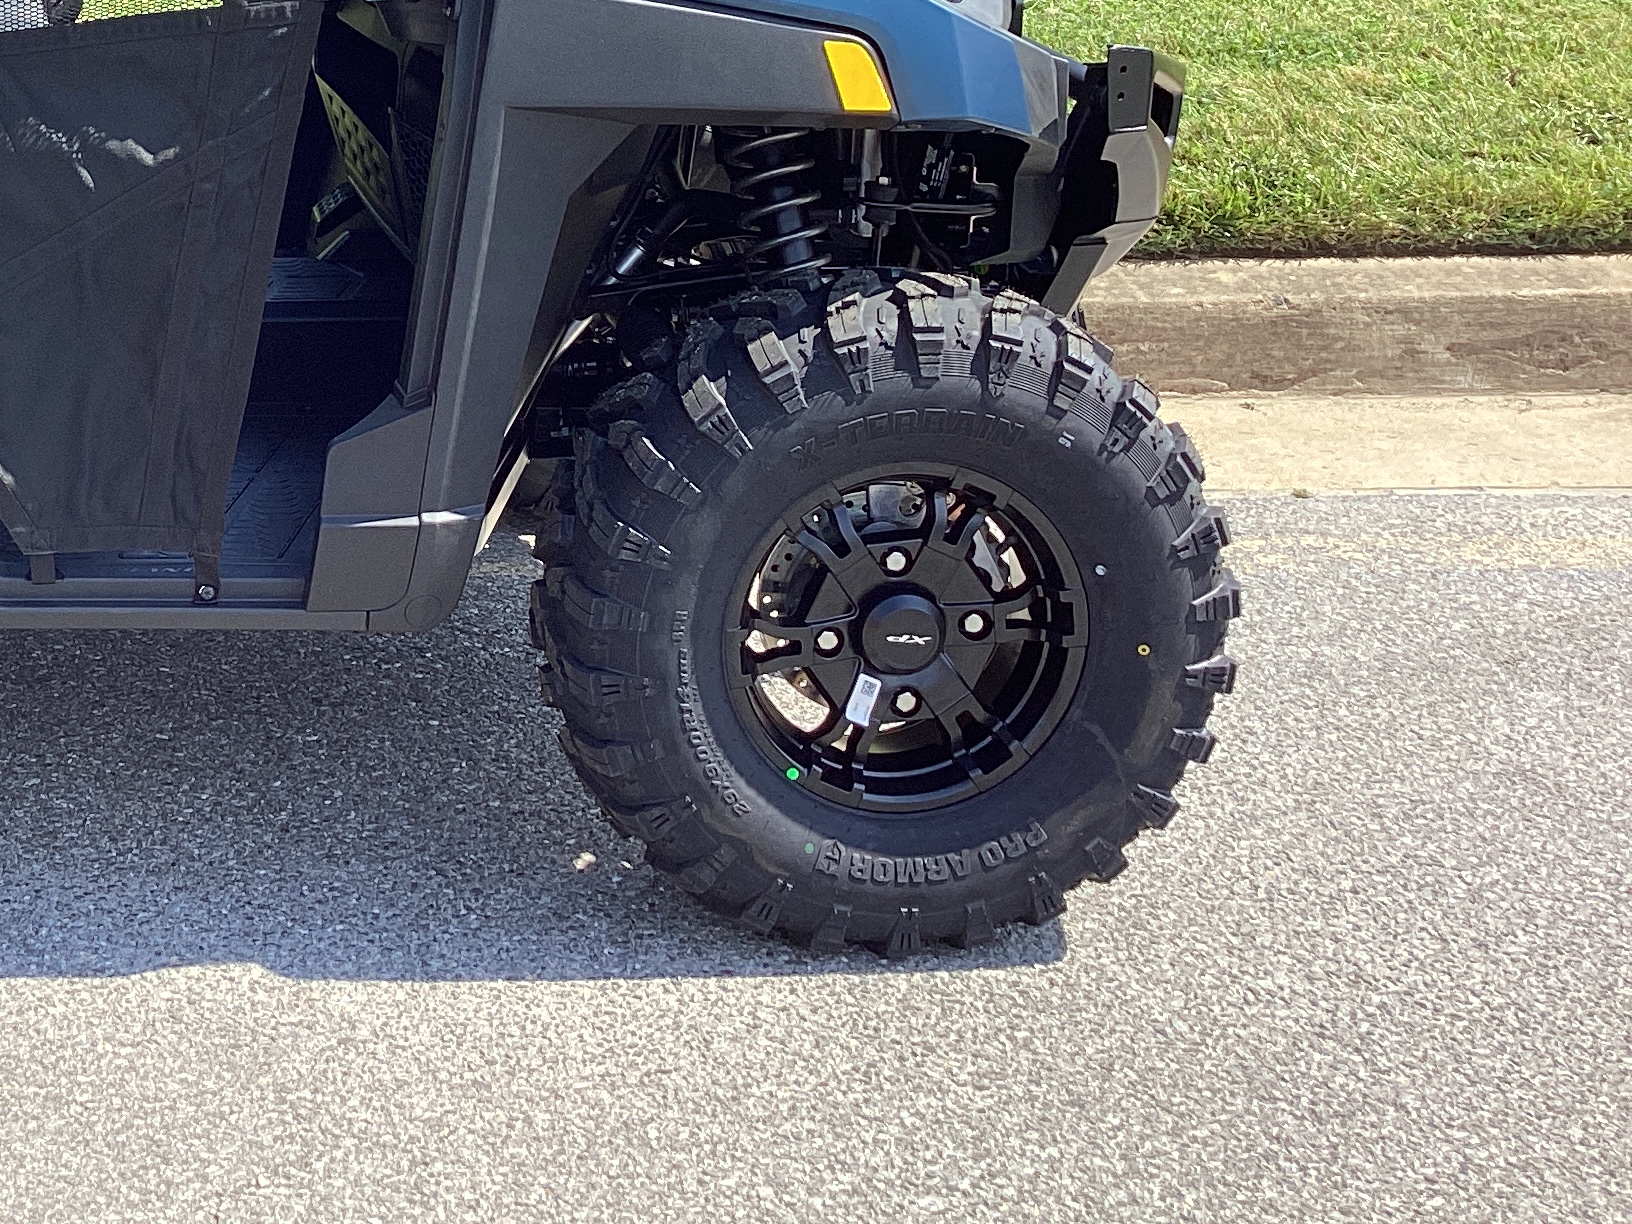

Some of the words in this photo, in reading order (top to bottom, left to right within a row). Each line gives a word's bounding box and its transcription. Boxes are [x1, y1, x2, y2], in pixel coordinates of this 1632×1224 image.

[790, 407, 1025, 472] X-TERRAIN
[848, 849, 972, 884] ARMOR
[977, 821, 1049, 868] PRO
